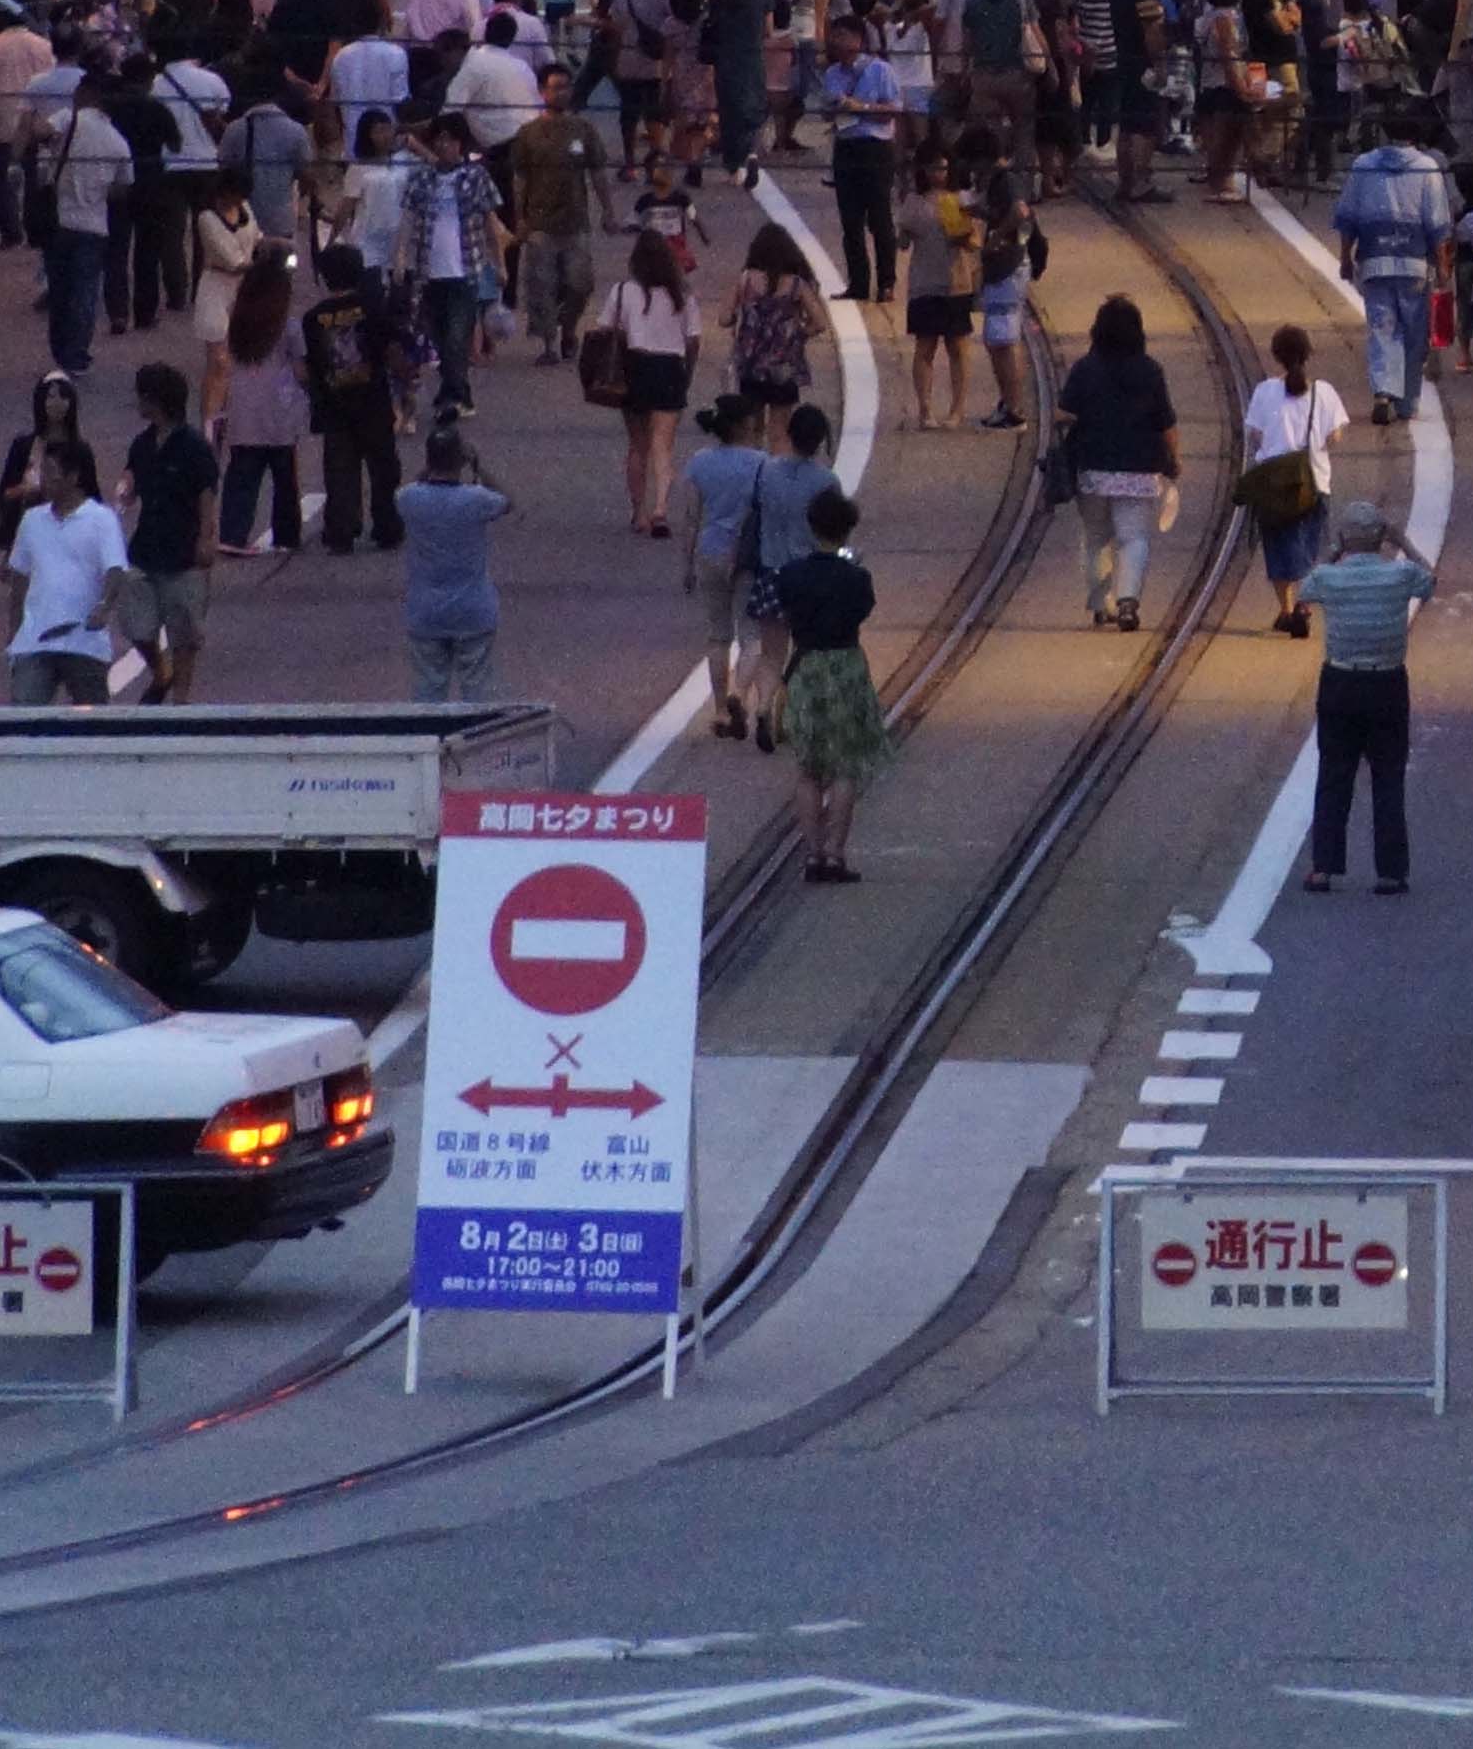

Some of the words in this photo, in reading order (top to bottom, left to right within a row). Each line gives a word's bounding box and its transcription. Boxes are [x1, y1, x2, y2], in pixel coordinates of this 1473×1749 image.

[480, 802, 675, 833] 高岡七夕まつり
[436, 1131, 550, 1152] 国道8号線
[607, 1135, 650, 1155] 富山
[446, 1159, 537, 1180] 砺波方面
[581, 1161, 672, 1182] 伏木方面
[1206, 1220, 1343, 1272] 通行止
[1211, 1284, 1340, 1309] 高岡警察署
